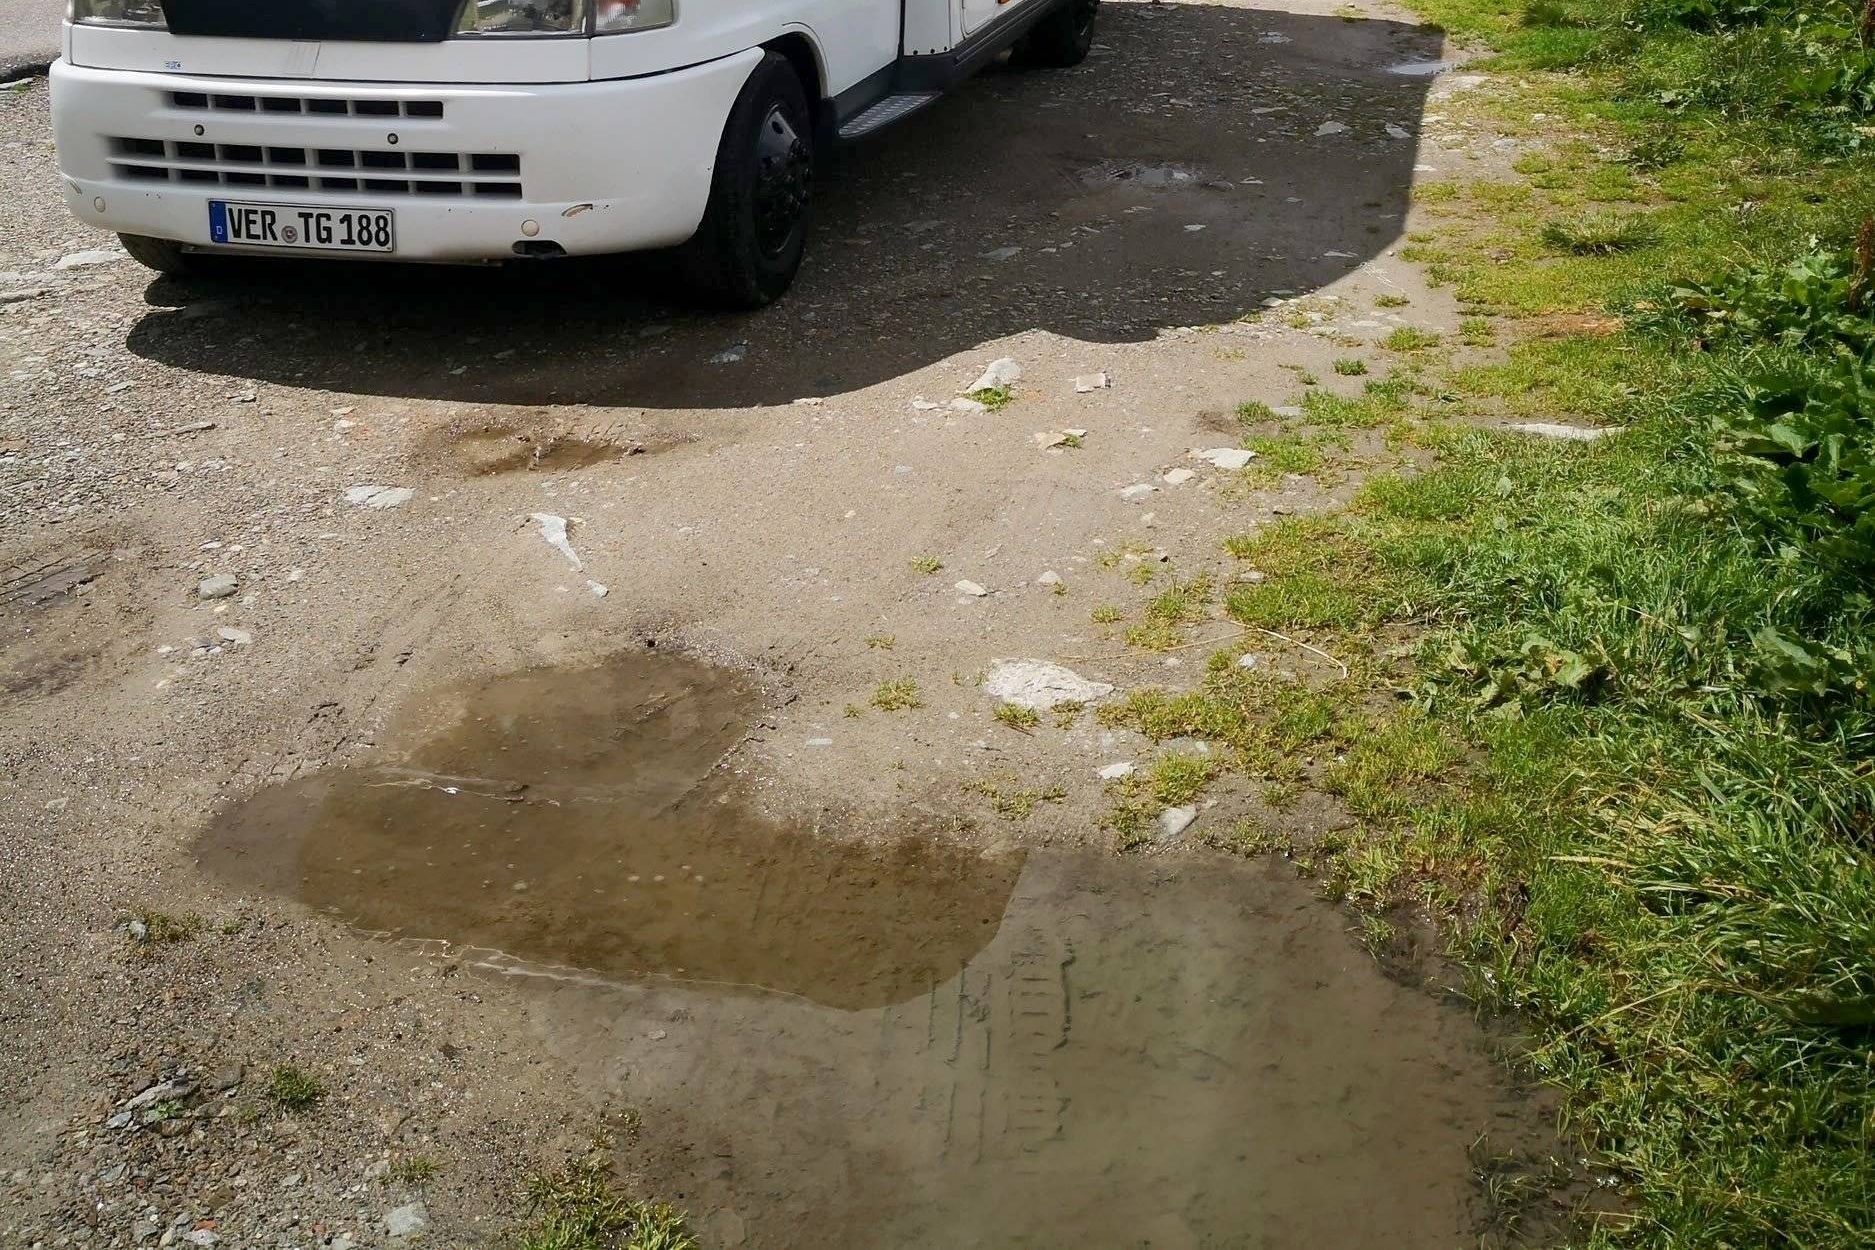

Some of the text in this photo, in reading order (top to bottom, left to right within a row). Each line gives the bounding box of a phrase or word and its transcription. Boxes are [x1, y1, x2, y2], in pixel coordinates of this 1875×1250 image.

[215, 225, 224, 235] D
[227, 207, 390, 247] VER TG 188
